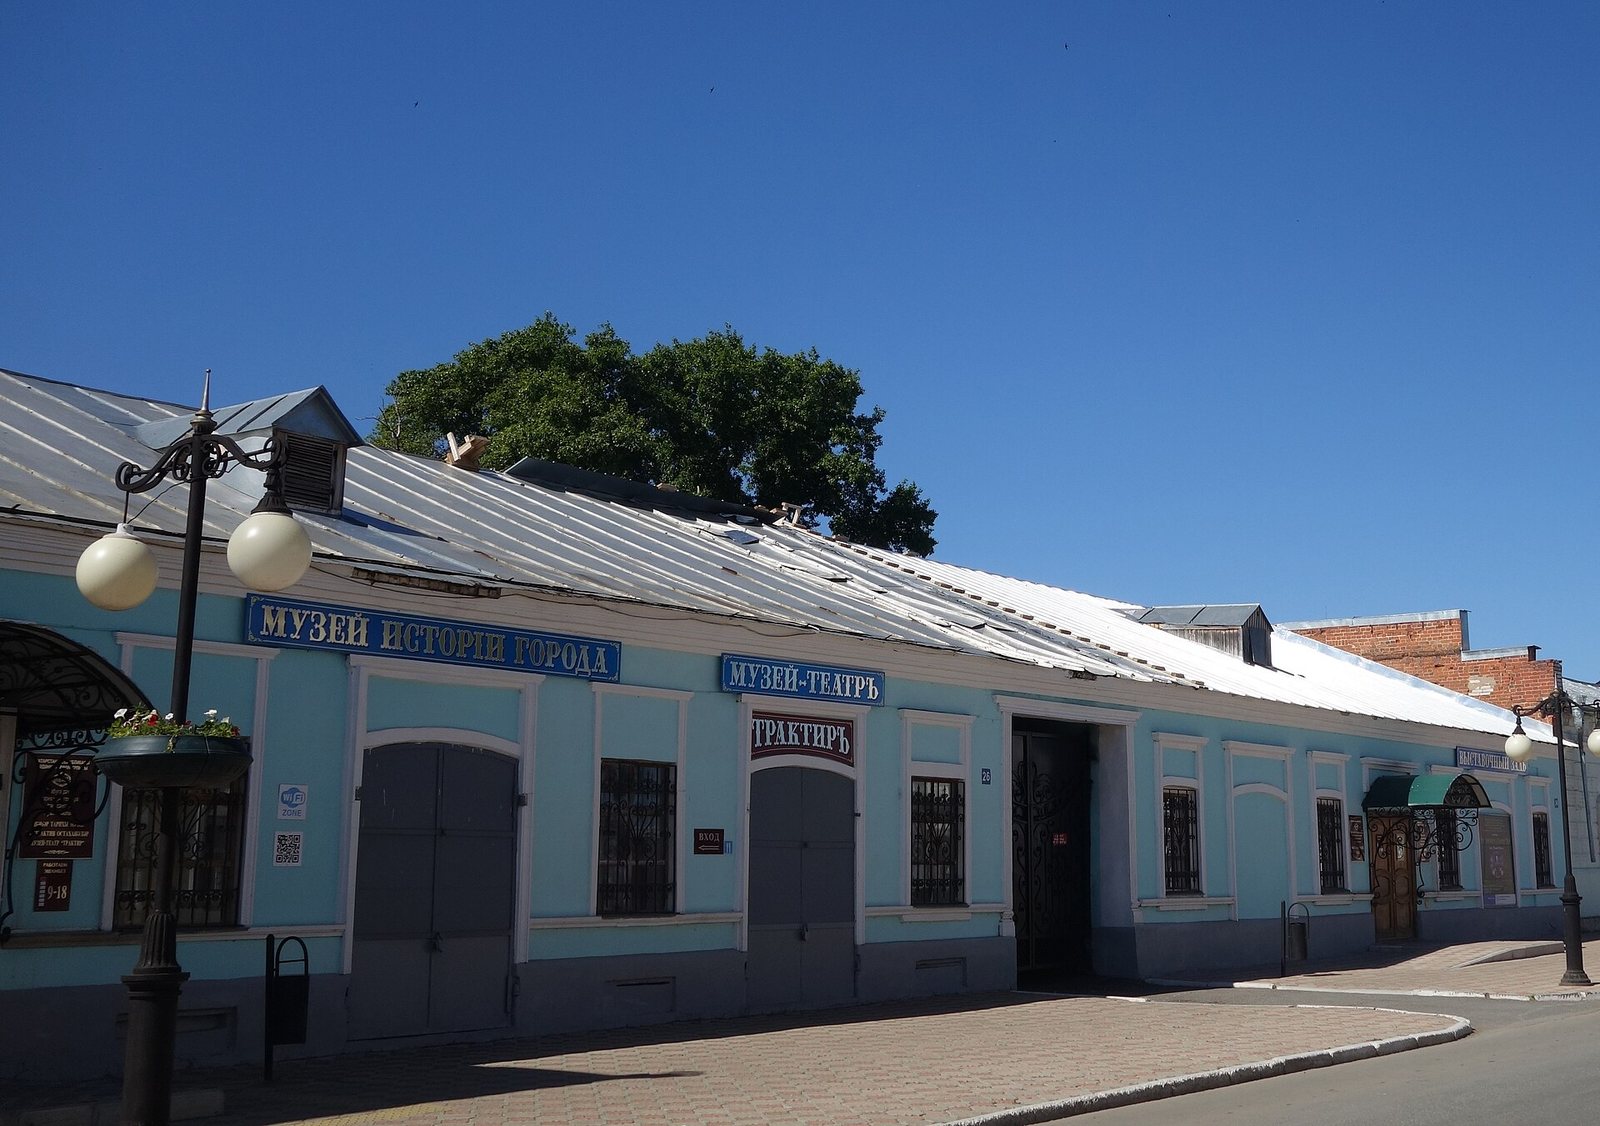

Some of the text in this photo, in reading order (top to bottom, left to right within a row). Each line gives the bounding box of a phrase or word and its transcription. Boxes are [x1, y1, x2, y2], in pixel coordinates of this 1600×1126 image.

[259, 603, 369, 648] МУЗЕЙ
[513, 635, 608, 676] ГОРОДА
[729, 660, 879, 700] МУЗЕЙ-ТЕАТРЪ
[752, 718, 850, 755] ТРАКТИРЪ
[281, 808, 302, 817] ZONE
[698, 832, 720, 842] ВХОД
[47, 885, 68, 900] 9-18
